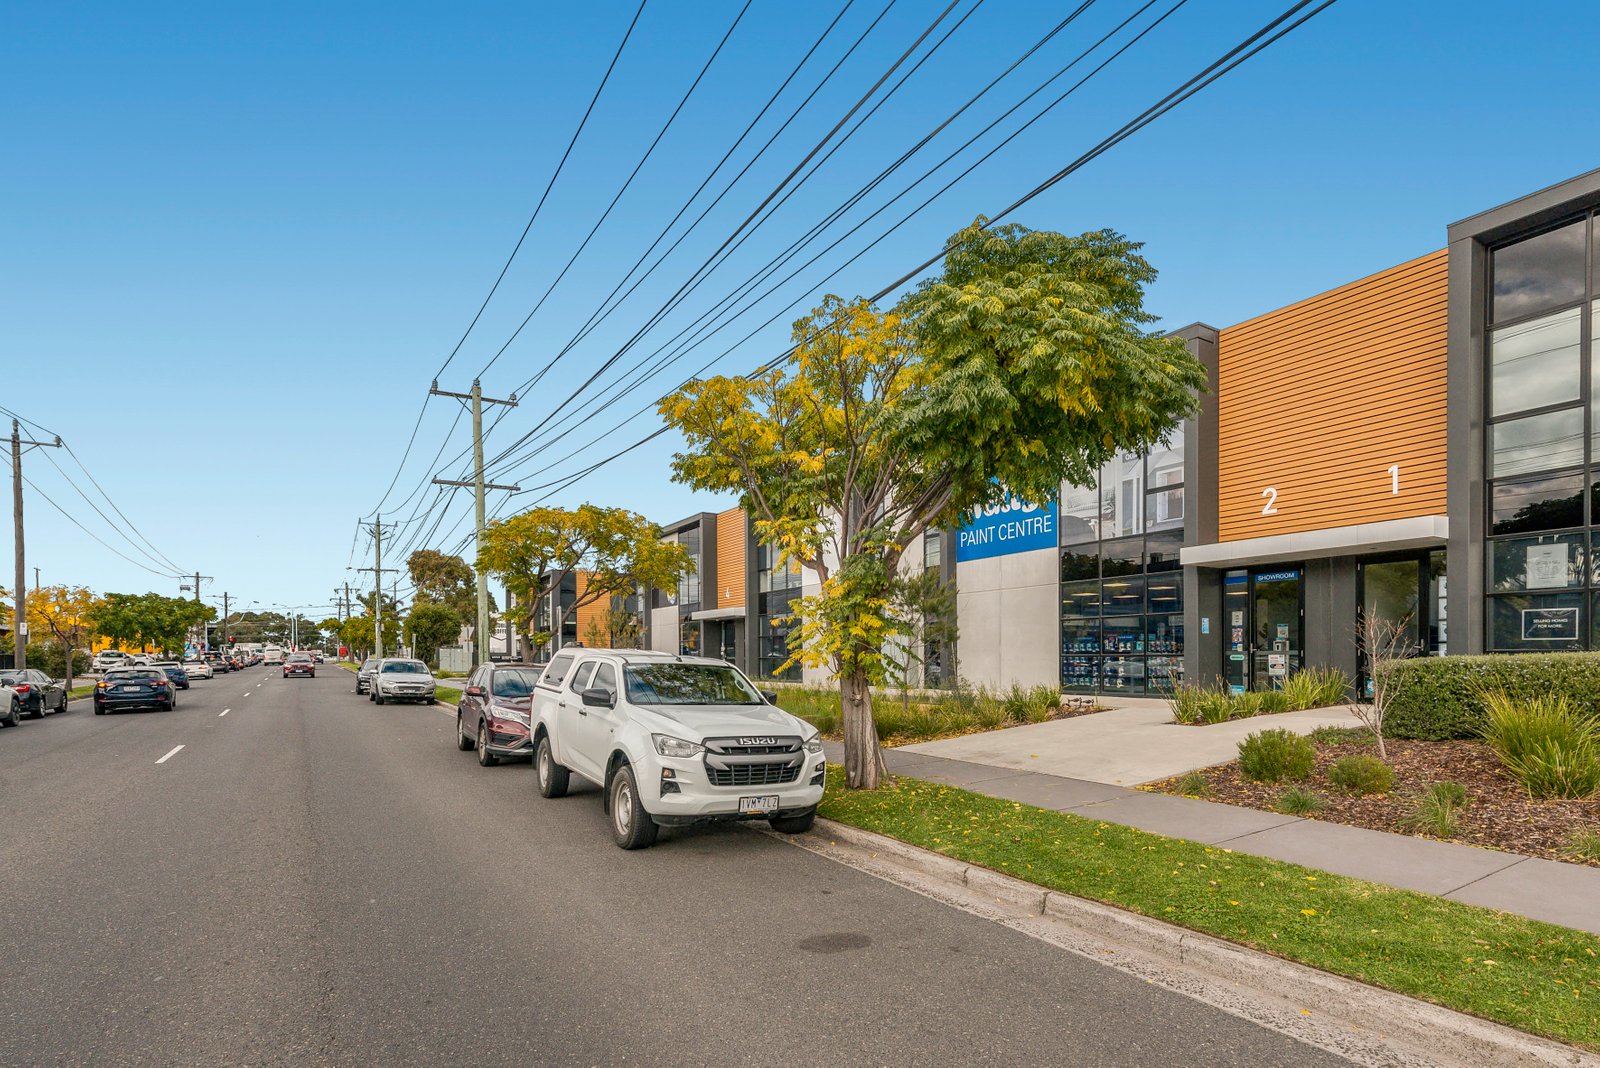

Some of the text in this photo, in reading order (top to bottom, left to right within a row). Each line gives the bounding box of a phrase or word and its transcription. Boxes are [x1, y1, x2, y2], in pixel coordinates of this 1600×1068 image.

[1387, 464, 1399, 495] 1
[1261, 487, 1278, 515] 2
[960, 514, 1053, 548] PAINT CENTRE
[1257, 572, 1295, 581] SHOWROOM
